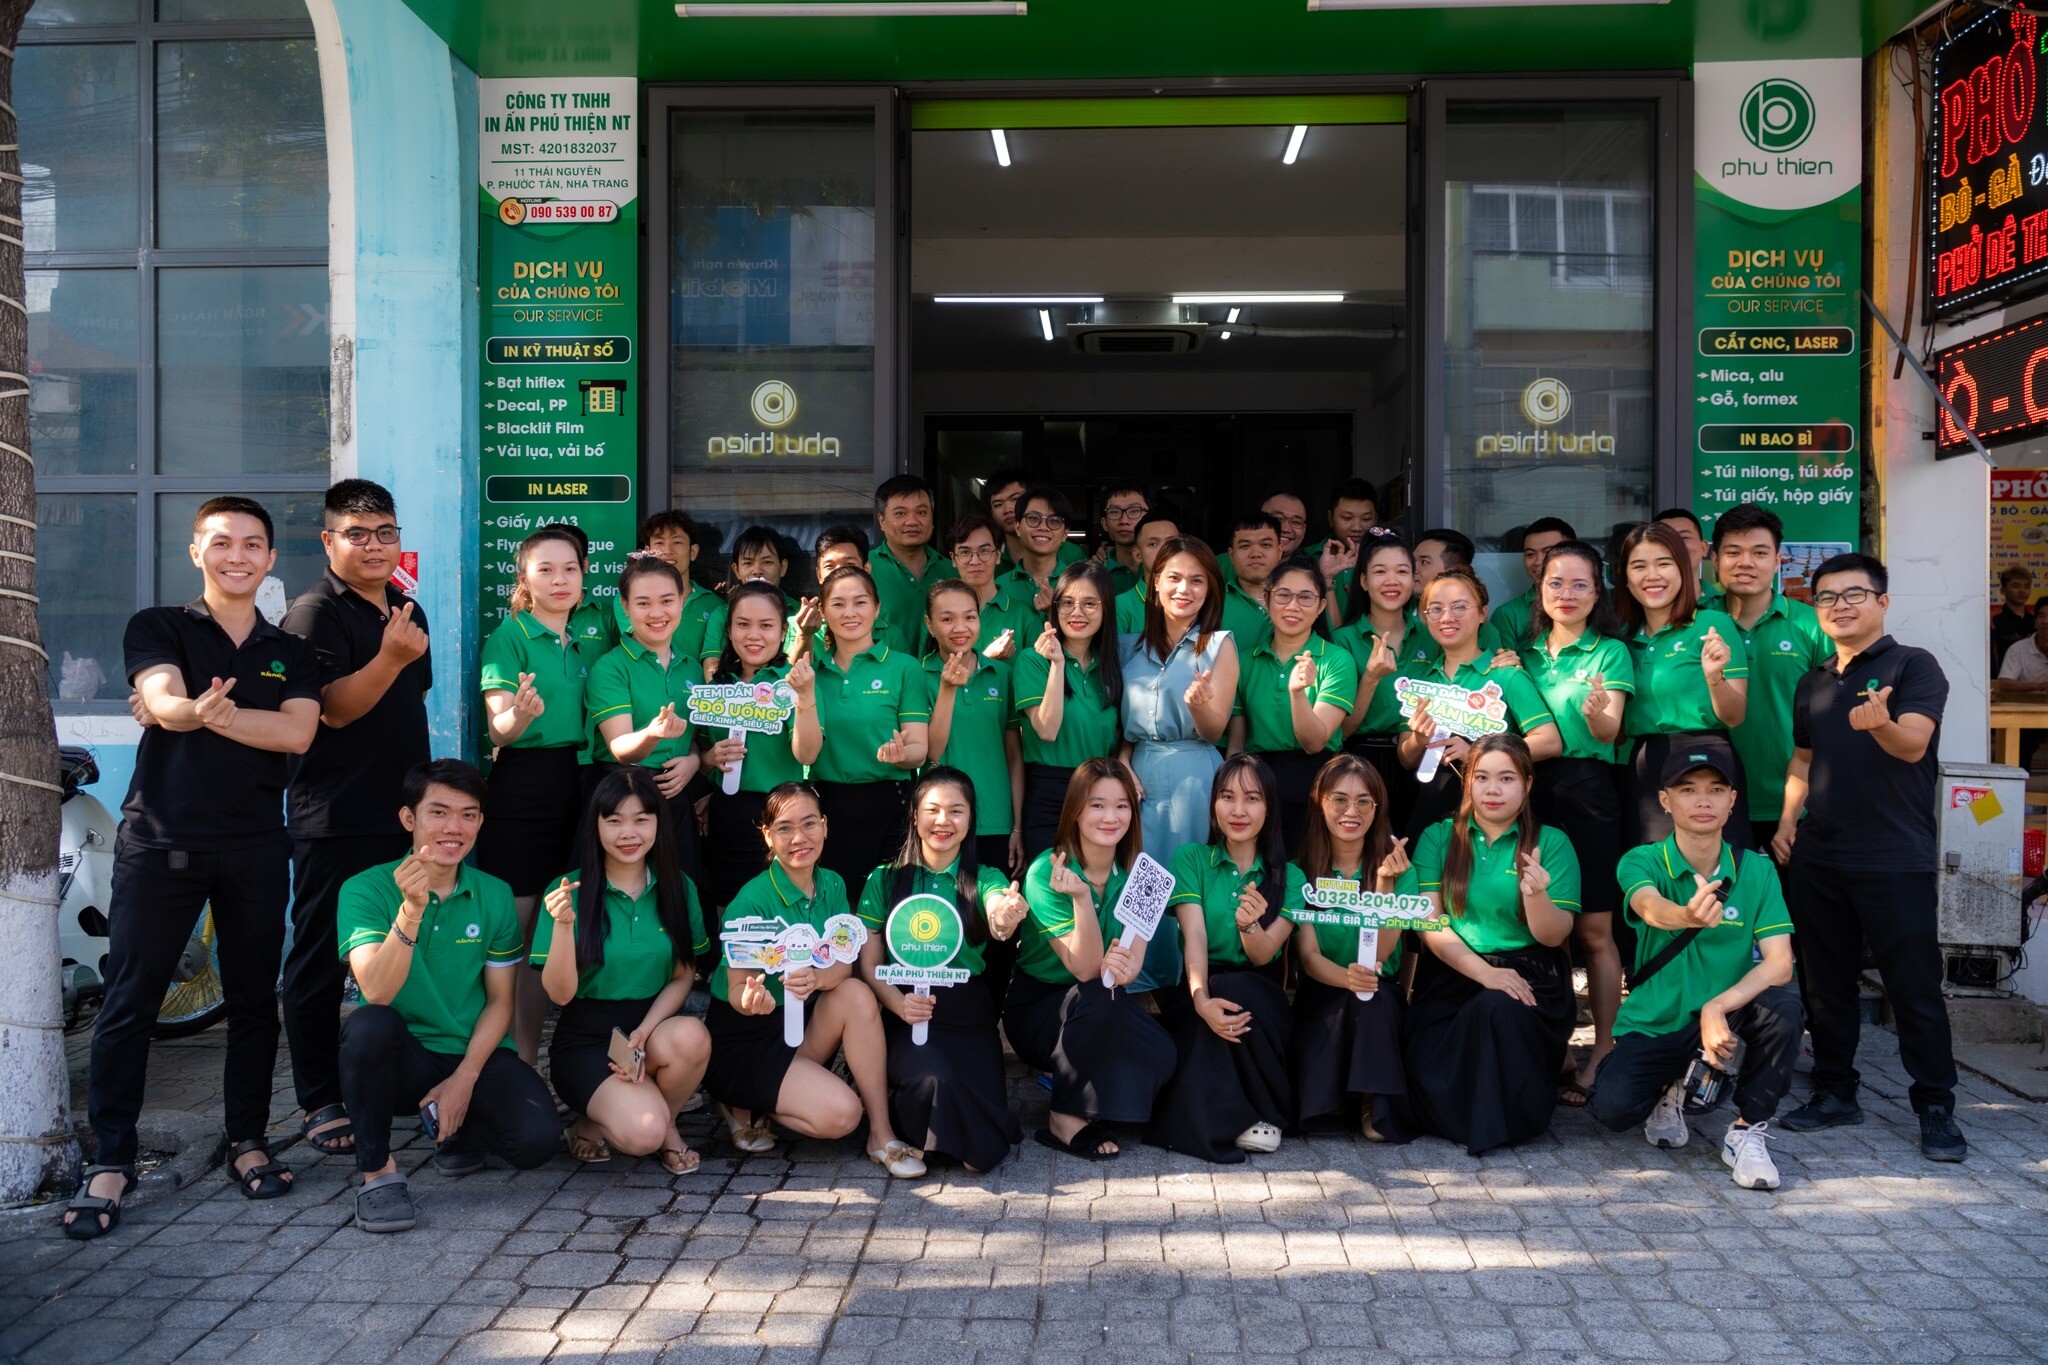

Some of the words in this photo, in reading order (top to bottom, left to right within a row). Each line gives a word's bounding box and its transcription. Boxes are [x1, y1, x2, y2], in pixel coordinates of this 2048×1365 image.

[506, 91, 546, 110] CÔNG
[551, 93, 567, 109] TY
[572, 92, 610, 108] TNHH
[485, 117, 500, 132] IN
[505, 110, 525, 132] ẤN
[530, 111, 560, 132] PHÚ
[564, 112, 606, 134] THIỆN
[612, 115, 631, 130] NT
[501, 143, 534, 155] MST:
[538, 142, 617, 154] 4201832037
[514, 168, 525, 176] 11
[528, 165, 553, 177] THÁI
[556, 165, 601, 176] NGUYÊN
[1722, 158, 1768, 178] phu
[1777, 157, 1833, 175] thien
[487, 181, 495, 189] P.
[538, 177, 563, 190] TÂN,
[566, 180, 589, 189] NHA
[591, 179, 629, 188] TRANG
[1939, 177, 1972, 232] BÒ
[1988, 153, 2023, 208] GÀ
[531, 207, 551, 218] 090
[556, 206, 577, 218] 539
[580, 206, 594, 217] 00
[598, 205, 613, 217] 87
[1728, 249, 1786, 273] DỊCH
[1793, 249, 1824, 272] VỤ
[1938, 224, 1983, 297] PHỞ
[1986, 213, 2016, 279] DÊ
[513, 261, 567, 284] DỊCH
[574, 260, 604, 283] VỤ
[1711, 271, 1747, 289] CỦA
[1750, 271, 1810, 288] CHÚNG
[1815, 271, 1841, 288] TÔI
[498, 282, 532, 299] CỦA
[535, 281, 591, 299] CHÚNG
[595, 282, 620, 298] TÔI
[1727, 300, 1760, 313] OUR
[1764, 299, 1824, 313] SERVICE
[513, 310, 545, 322] OUR
[547, 309, 604, 322] SERVICE
[504, 345, 518, 357] IN
[522, 342, 541, 358] KỸ
[545, 344, 591, 360] THUẬT
[593, 340, 614, 357] SỐ
[1714, 332, 1746, 350] CẮT
[1750, 336, 1790, 351] CNC,
[1795, 336, 1838, 349] LASER
[497, 377, 522, 391] Bạt
[525, 376, 566, 389] hiflex
[1711, 369, 1754, 384] Mica,
[1759, 369, 1784, 381] alu
[497, 399, 544, 413] Decal,
[549, 399, 568, 411] PP
[1710, 390, 1739, 407] Gỗ,
[1742, 392, 1799, 405] formex
[497, 421, 551, 434] Blacklit
[555, 421, 584, 434] Film
[1740, 433, 1756, 446] IN
[1760, 432, 1794, 446] BAO
[1798, 430, 1813, 445] BÌ
[497, 443, 523, 457] Vải
[526, 444, 552, 460] lụa,
[557, 443, 581, 457] vải
[584, 442, 605, 457] bố
[1714, 464, 1736, 478] Túi
[1741, 465, 1794, 481] nilong,
[1798, 464, 1819, 478] túi
[1822, 463, 1854, 480] xốp
[528, 483, 543, 495] IN
[547, 482, 588, 495] LASER
[1714, 487, 1736, 501] Túi
[1783, 488, 1814, 504] hộp
[1818, 485, 1854, 504] giấy
[496, 512, 531, 530] Giấy
[695, 688, 722, 698] TEM
[724, 684, 753, 698] DÁN
[1412, 683, 1437, 695] TEM
[1438, 686, 1466, 701] DÁN
[1434, 701, 1462, 720] ĂN
[715, 716, 736, 725] XINH
[1317, 879, 1359, 891] HOTLINE
[1317, 891, 1430, 911] 0328.204.079
[1292, 910, 1315, 921] TEM
[1318, 910, 1340, 924] DÁN
[1343, 913, 1361, 925] GIÁ
[901, 942, 921, 951] phu
[923, 942, 947, 952] thien
[889, 966, 903, 977] ẤN
[905, 967, 924, 978] PHÚ
[927, 969, 954, 981] THIỆN
[955, 972, 967, 980] NT
